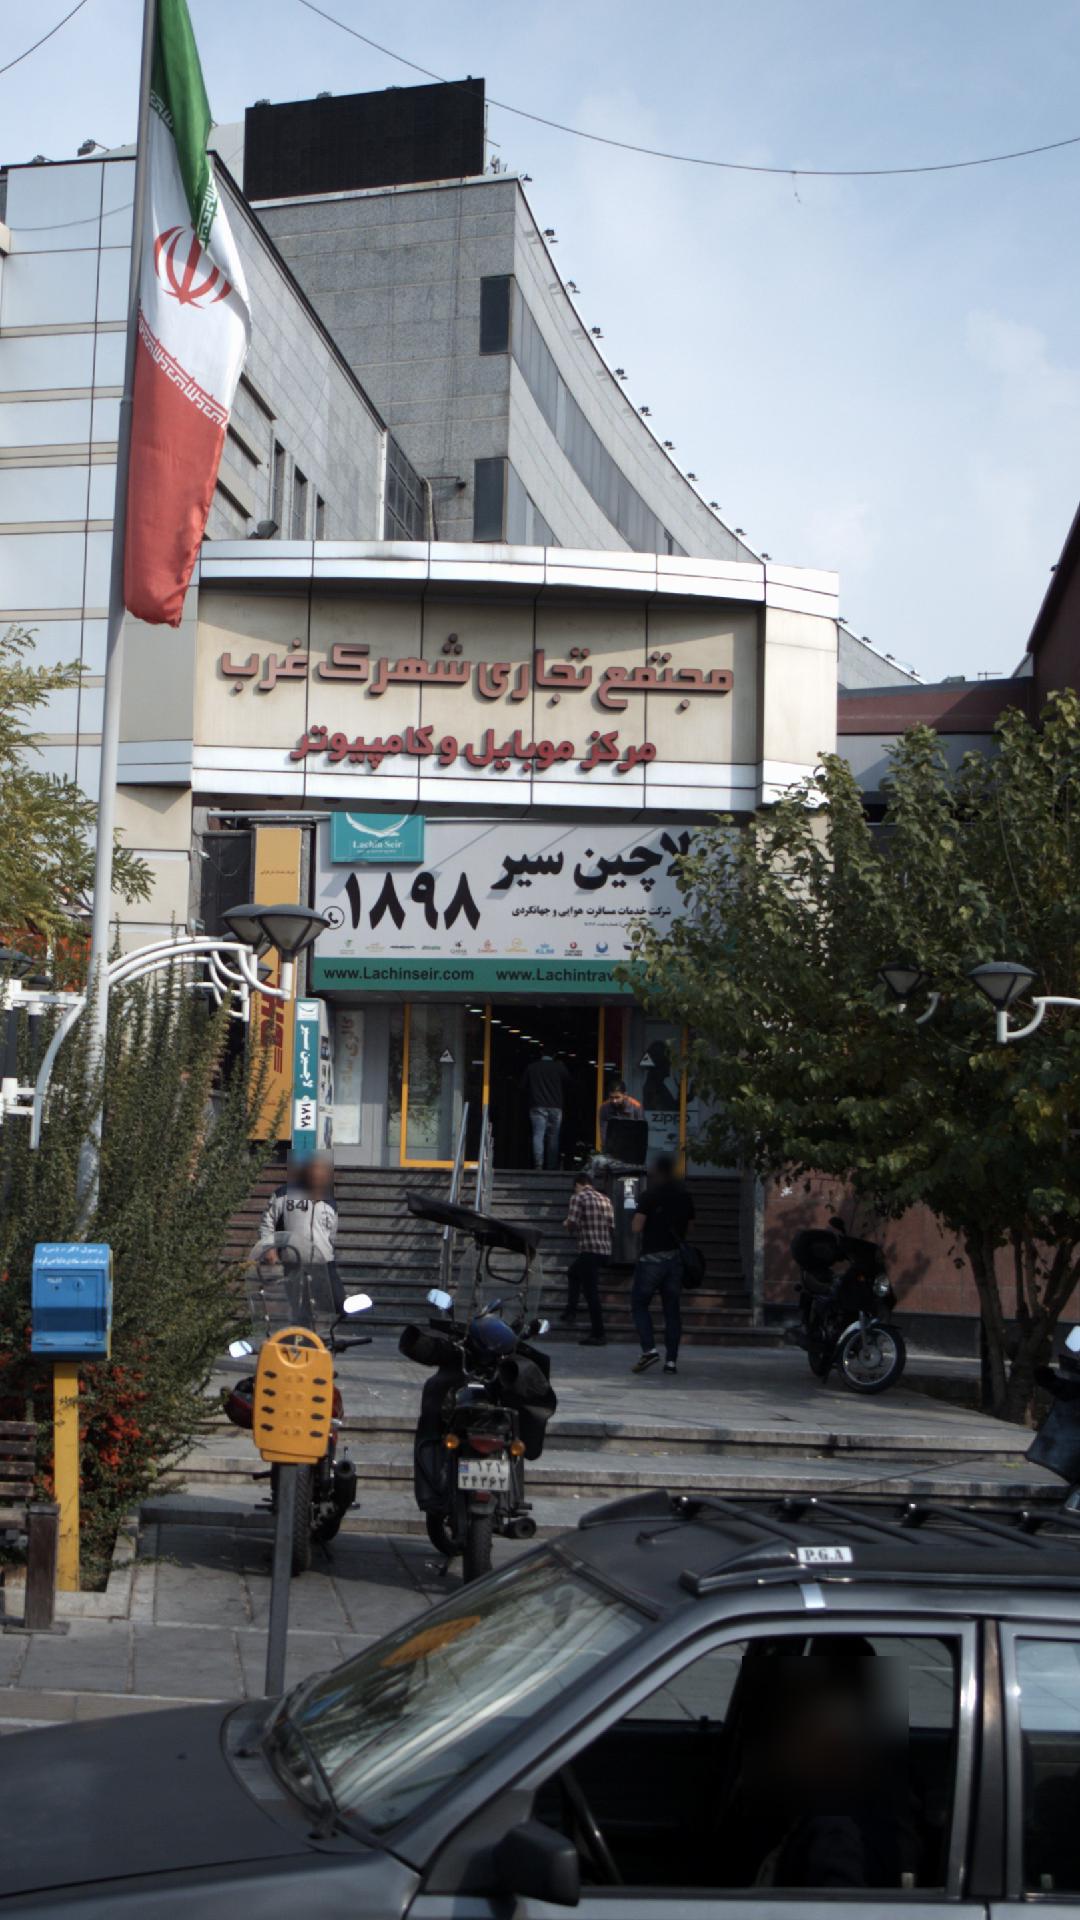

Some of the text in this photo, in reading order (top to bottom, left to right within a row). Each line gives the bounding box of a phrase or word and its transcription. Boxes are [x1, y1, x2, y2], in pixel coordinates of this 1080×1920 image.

[220, 633, 734, 709] مجتمع تجاری شهرک غرب
[290, 725, 656, 772] مرکز موبایل و کامپیوتر
[352, 840, 383, 849] Lachin
[490, 831, 690, 892] لاچین سیر
[345, 872, 480, 930] ۱۸۹۸
[618, 906, 647, 915] خدمات
[648, 905, 672, 918] شرکت
[323, 967, 474, 981] www.Lachinseir.com
